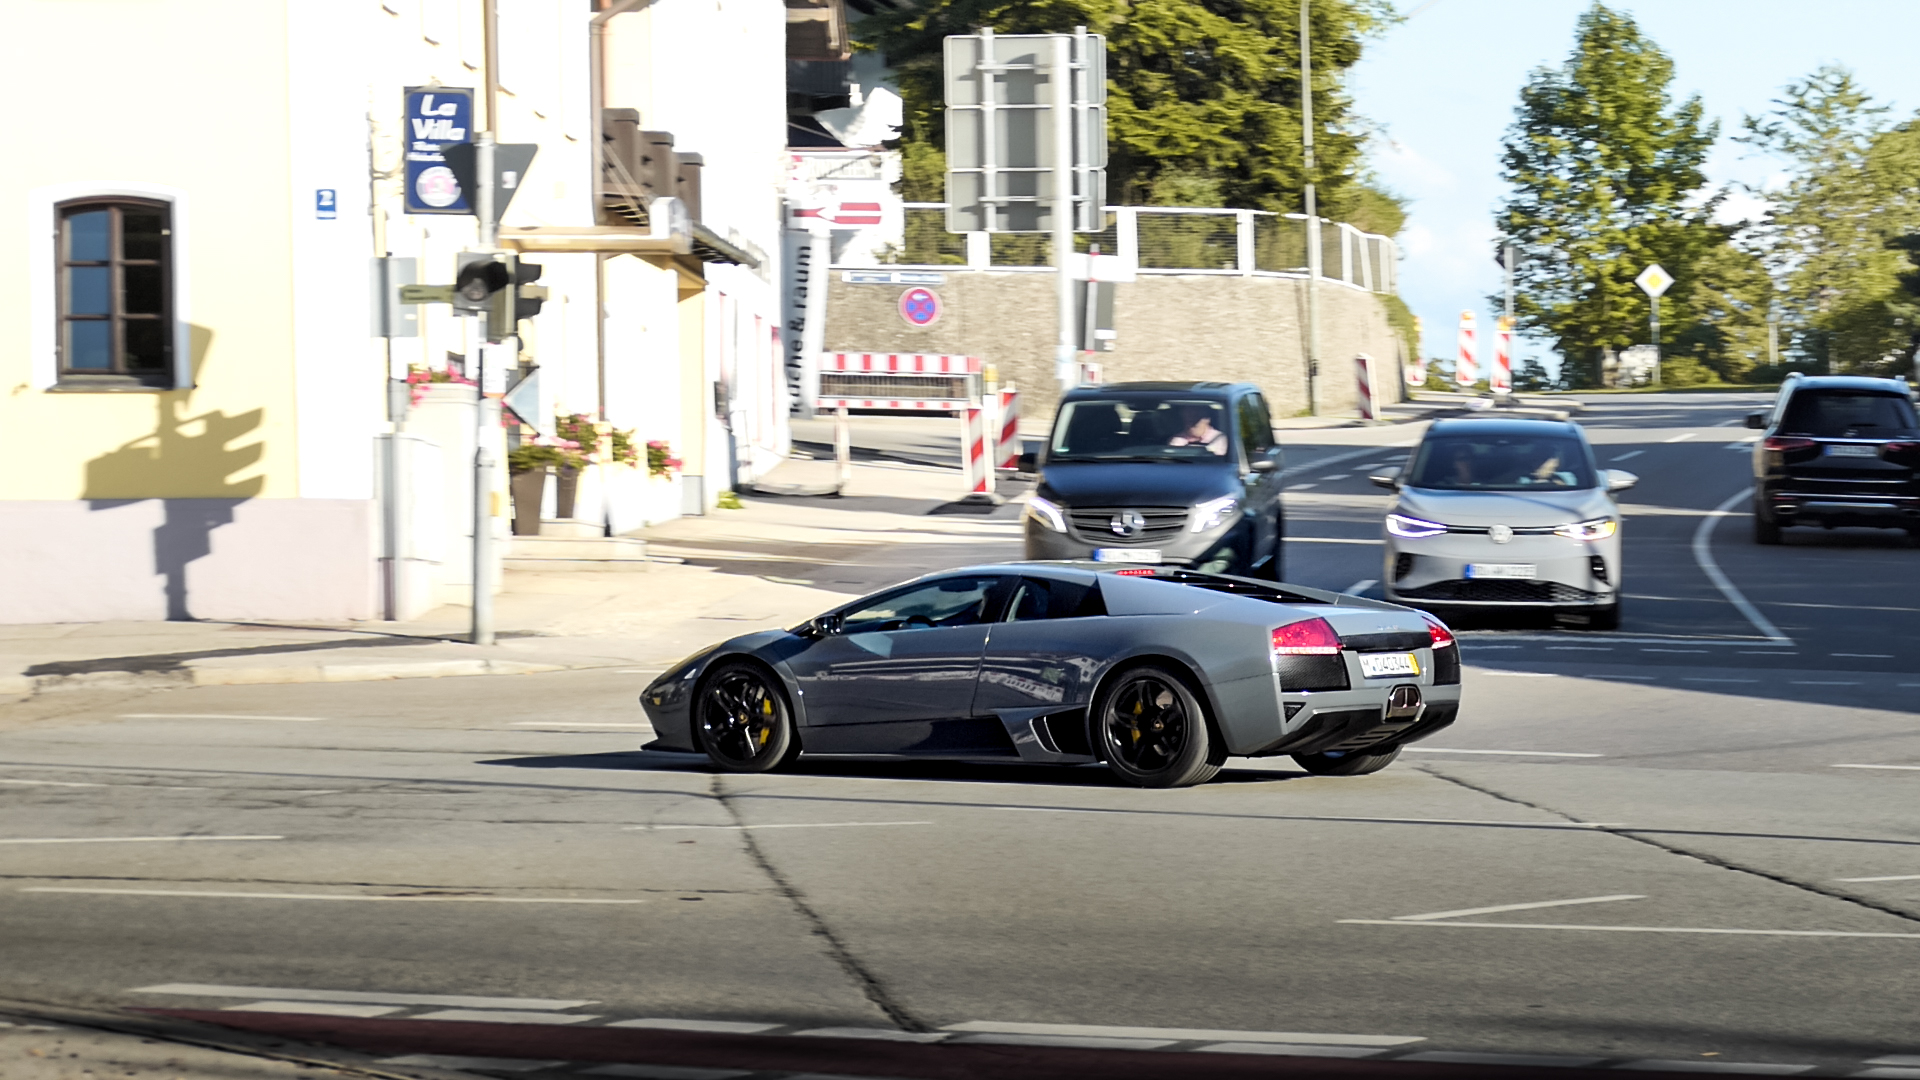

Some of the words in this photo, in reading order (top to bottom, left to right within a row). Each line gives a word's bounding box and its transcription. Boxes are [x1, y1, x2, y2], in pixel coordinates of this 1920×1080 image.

[421, 94, 458, 116] La
[411, 118, 466, 141] Villa
[319, 190, 334, 206] 2
[793, 245, 812, 310] raum
